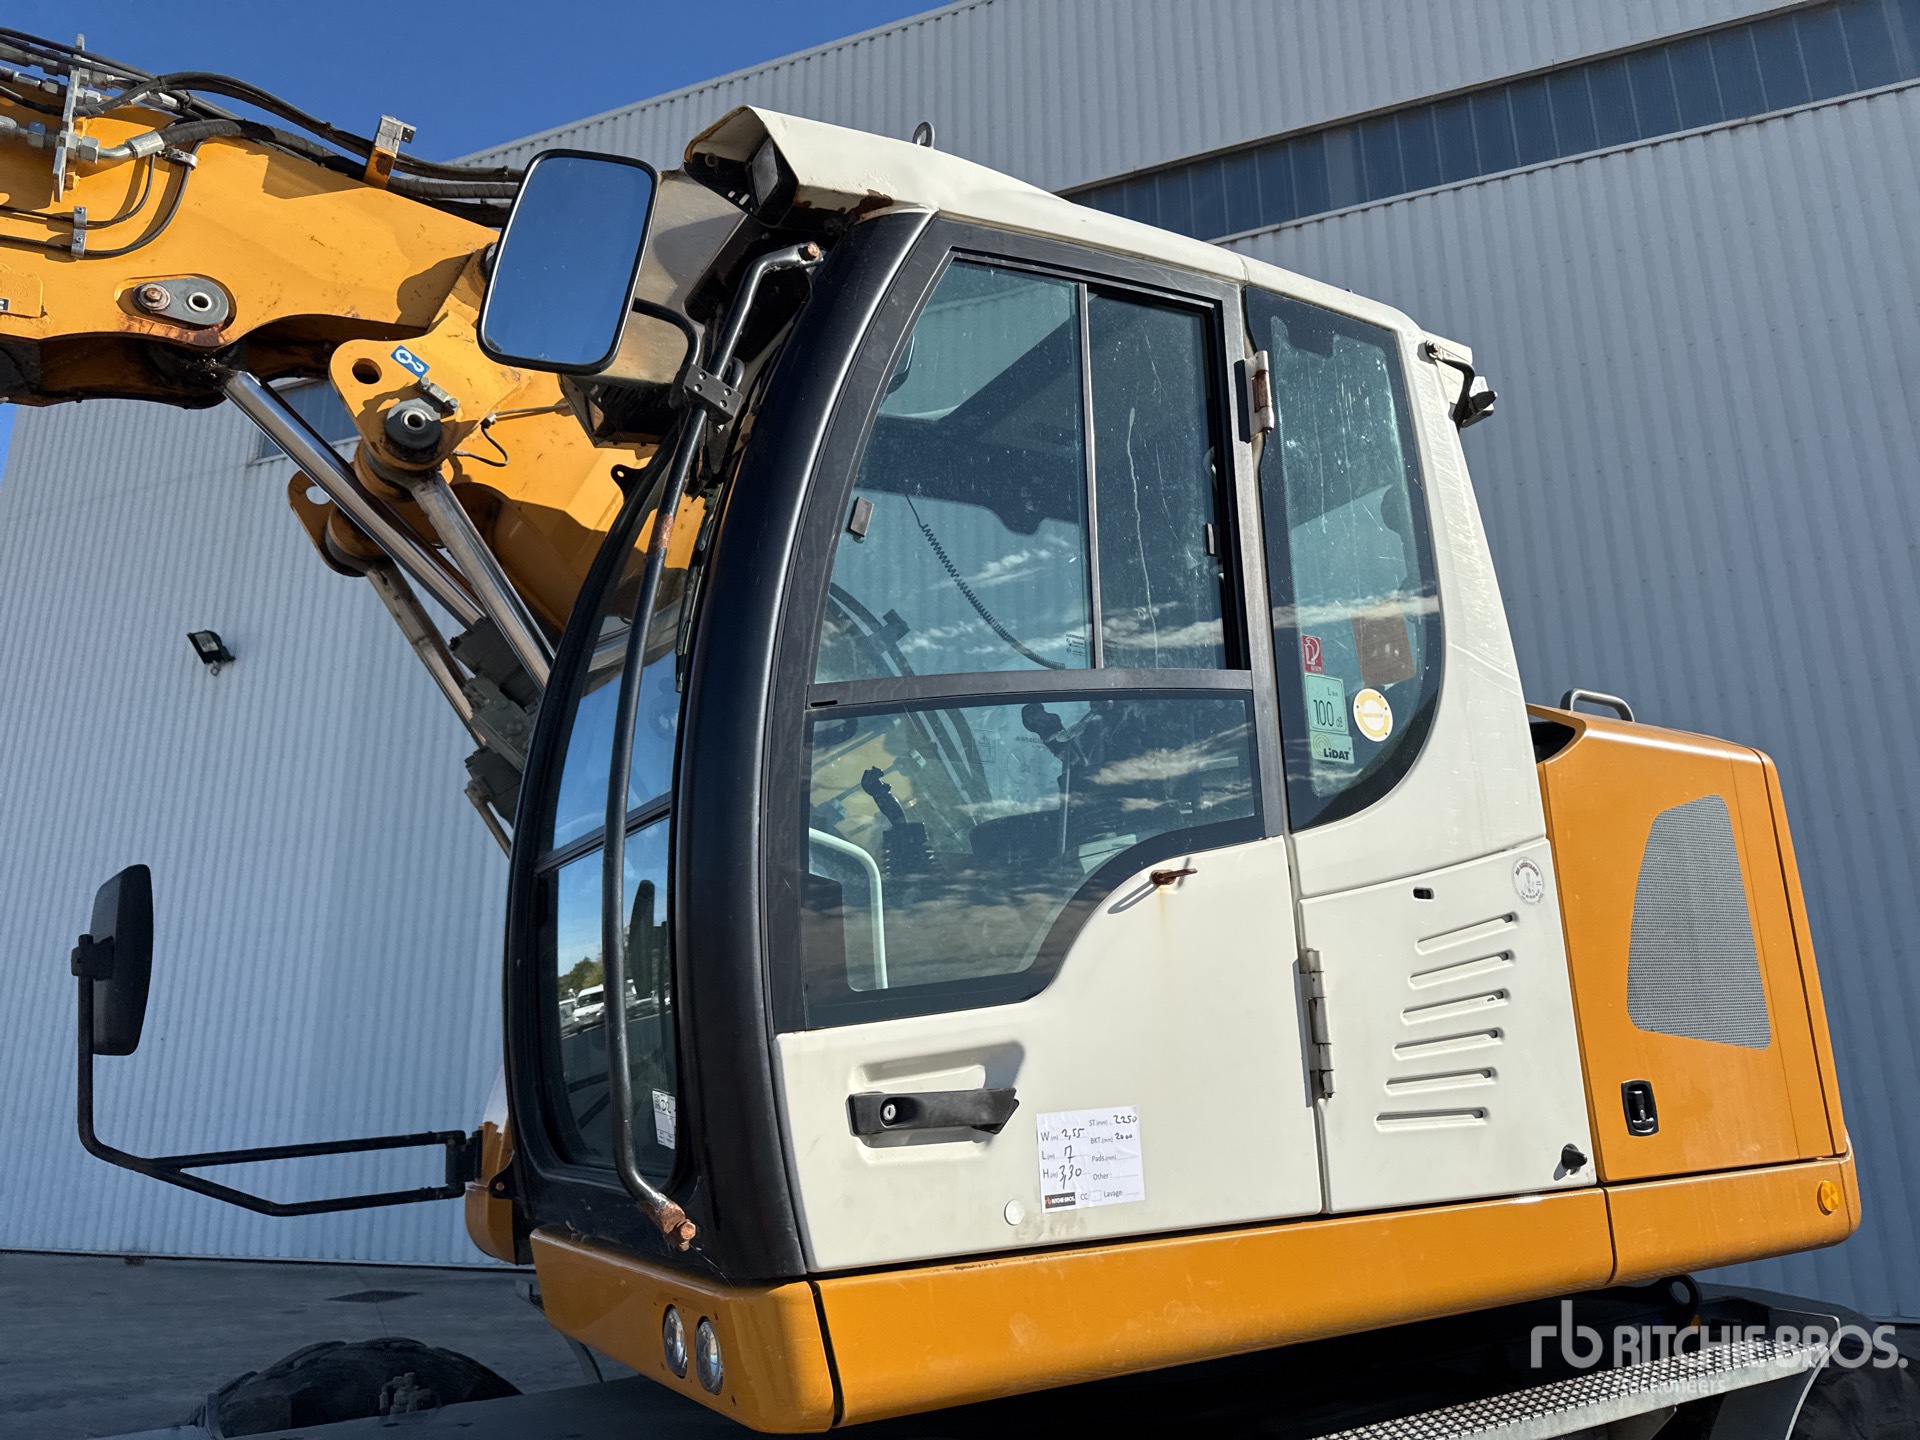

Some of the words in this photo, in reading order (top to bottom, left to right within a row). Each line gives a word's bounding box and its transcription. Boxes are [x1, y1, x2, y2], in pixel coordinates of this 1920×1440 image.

[1313, 700, 1334, 727] 100
[1323, 747, 1350, 761] LiDAT
[1113, 1114, 1138, 1125] 2250
[1061, 1127, 1085, 1141] 2,55
[1064, 1144, 1075, 1164] 7
[1059, 1164, 1083, 1190] 3,30
